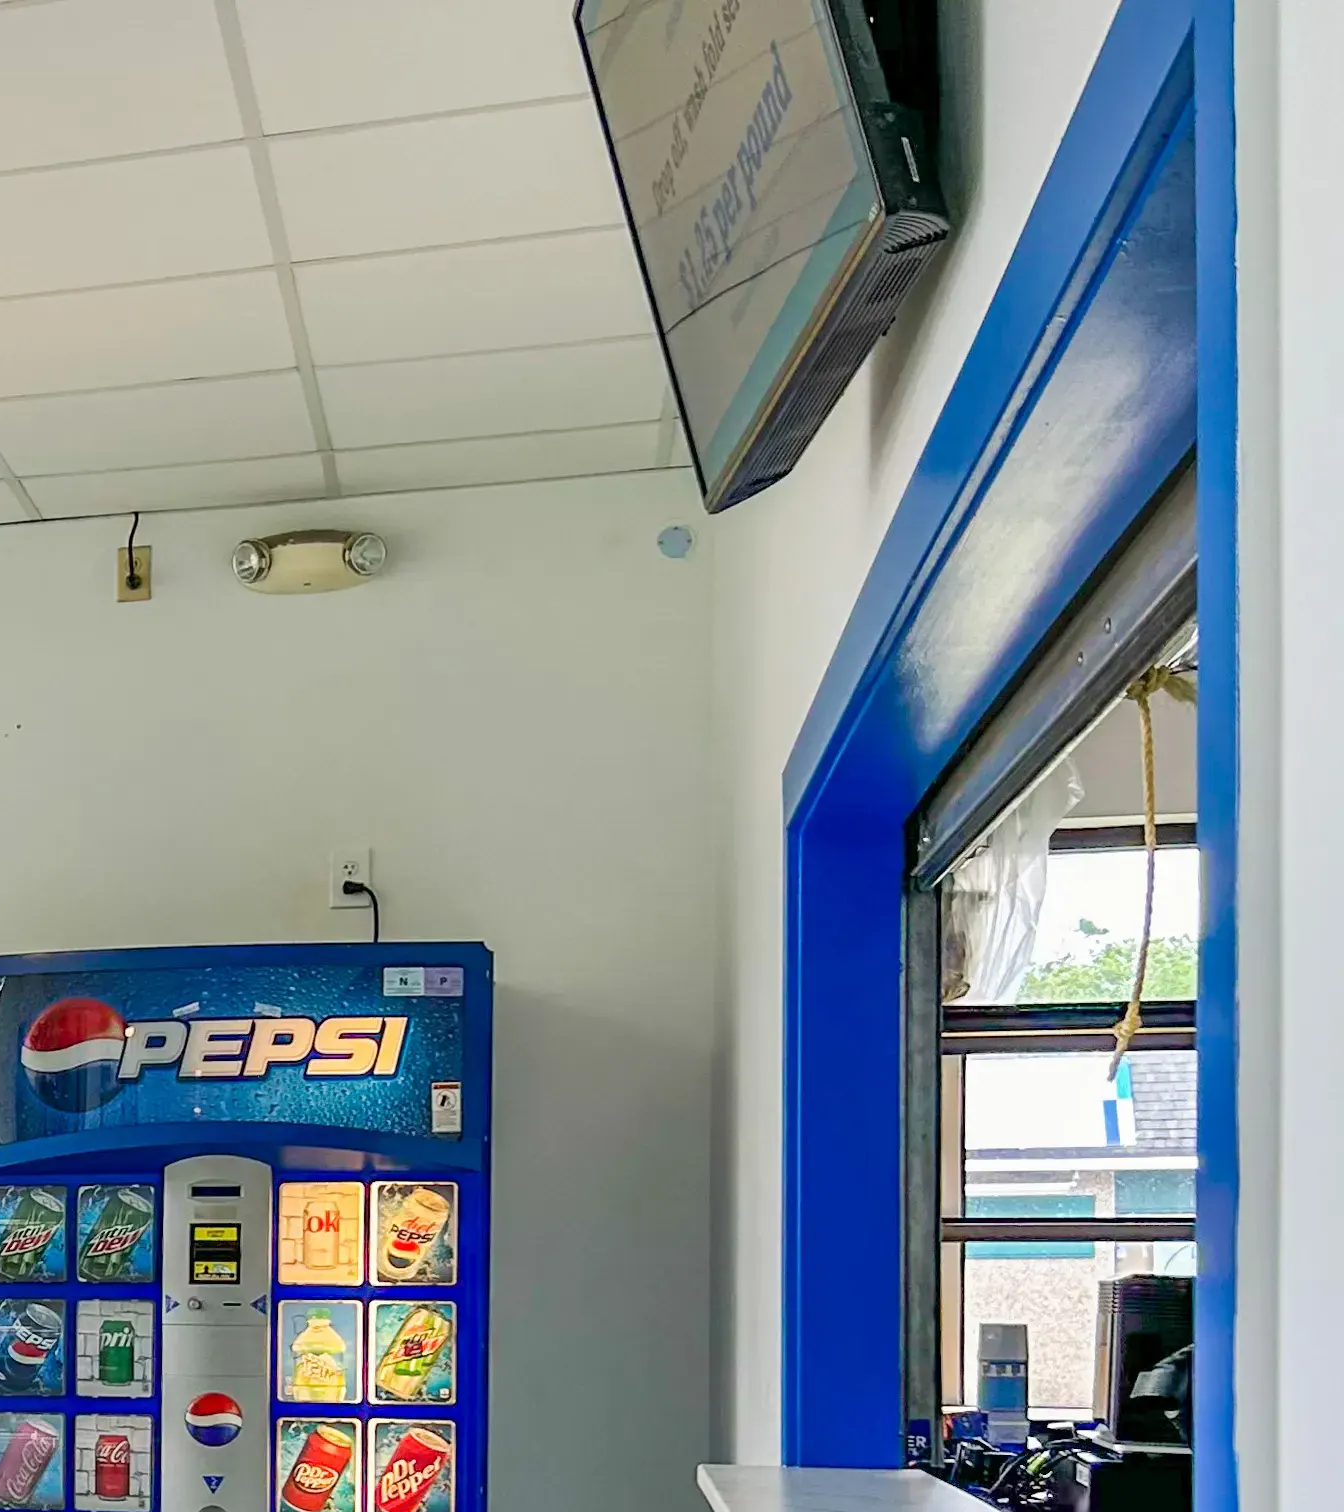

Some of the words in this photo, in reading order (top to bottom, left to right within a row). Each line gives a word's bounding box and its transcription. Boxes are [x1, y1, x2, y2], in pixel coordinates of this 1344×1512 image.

[712, 164, 743, 266] per
[737, 39, 793, 213] pound
[399, 977, 408, 986] N
[440, 977, 448, 986] P
[117, 1016, 409, 1080] PEPSI
[381, 1456, 442, 1503] Pepper
[393, 1459, 416, 1481] Dr
